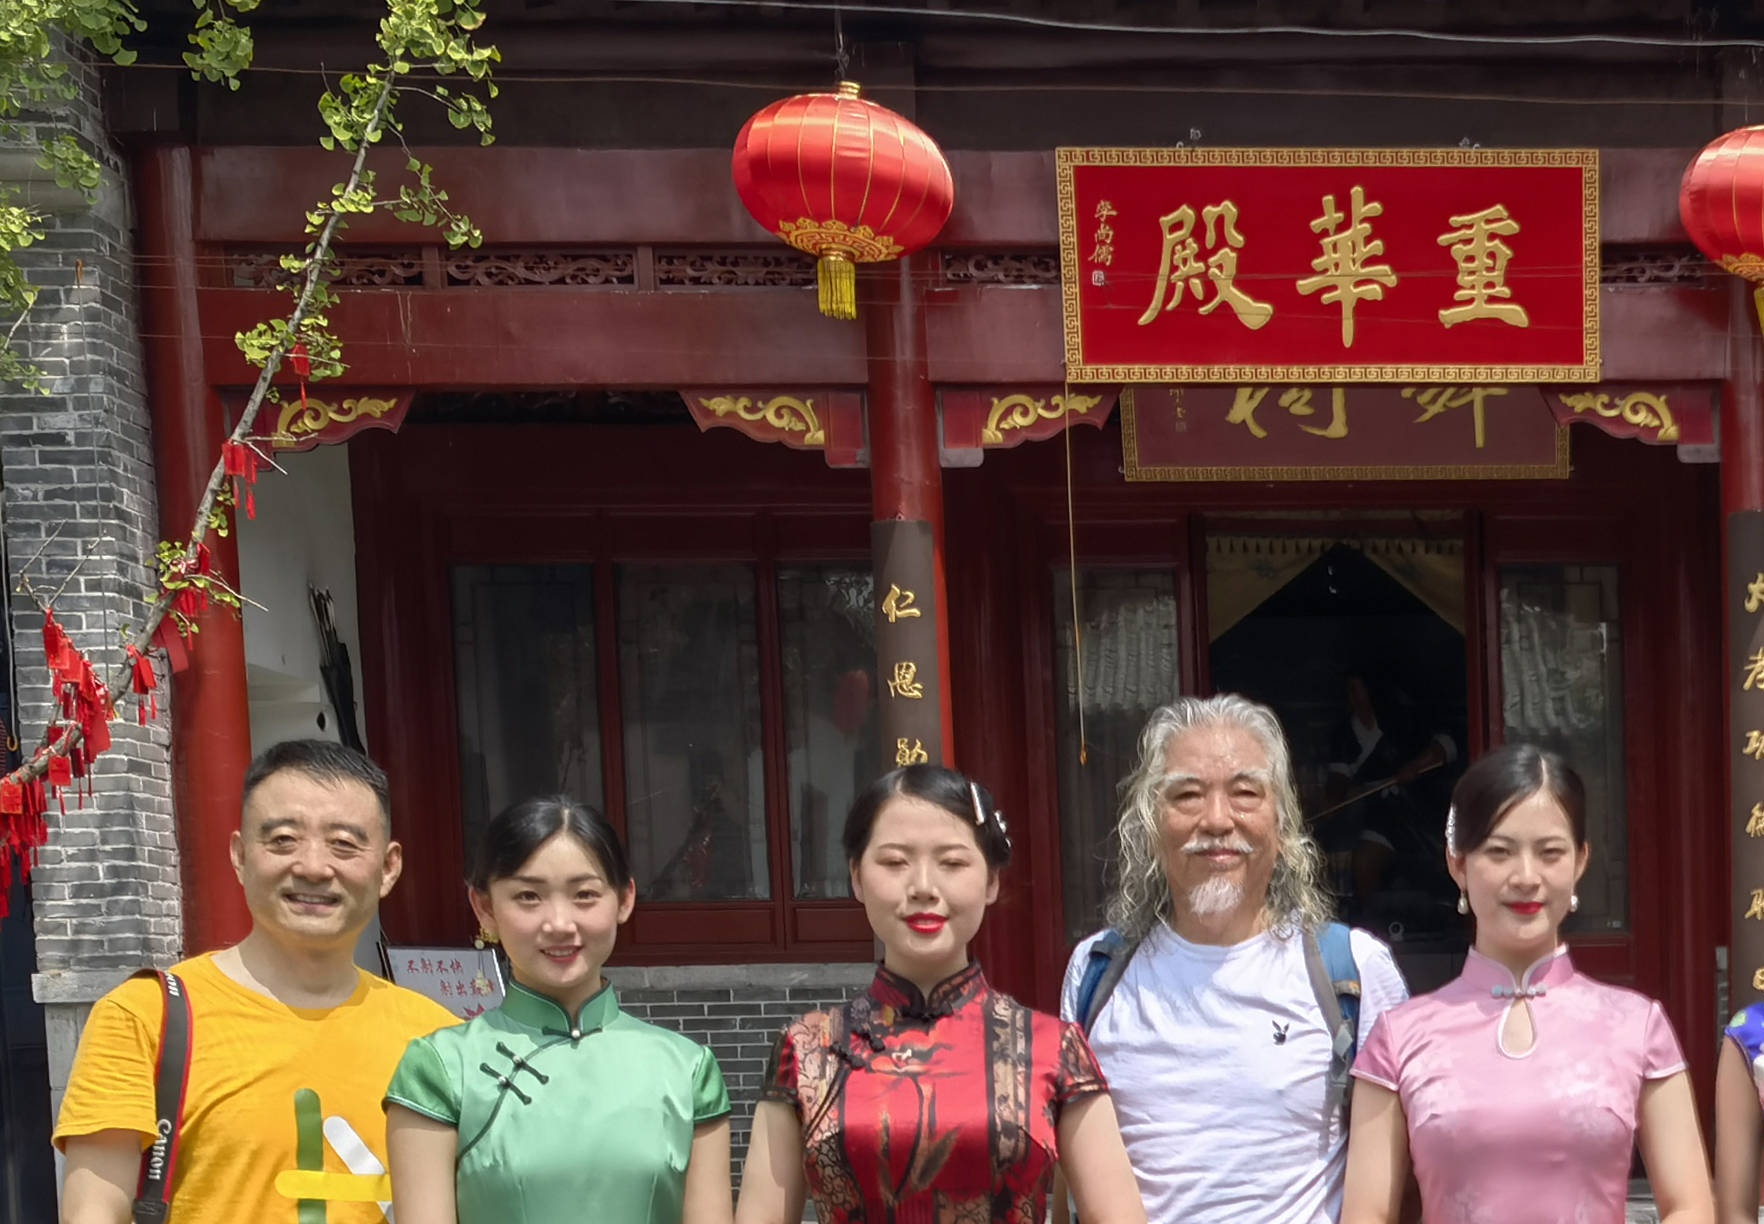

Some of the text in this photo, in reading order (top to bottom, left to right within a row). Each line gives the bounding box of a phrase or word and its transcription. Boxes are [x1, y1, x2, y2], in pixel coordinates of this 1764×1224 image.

[1137, 185, 1529, 348] 重華殿
[165, 970, 181, 997] non
[148, 1118, 172, 1181] Canon
